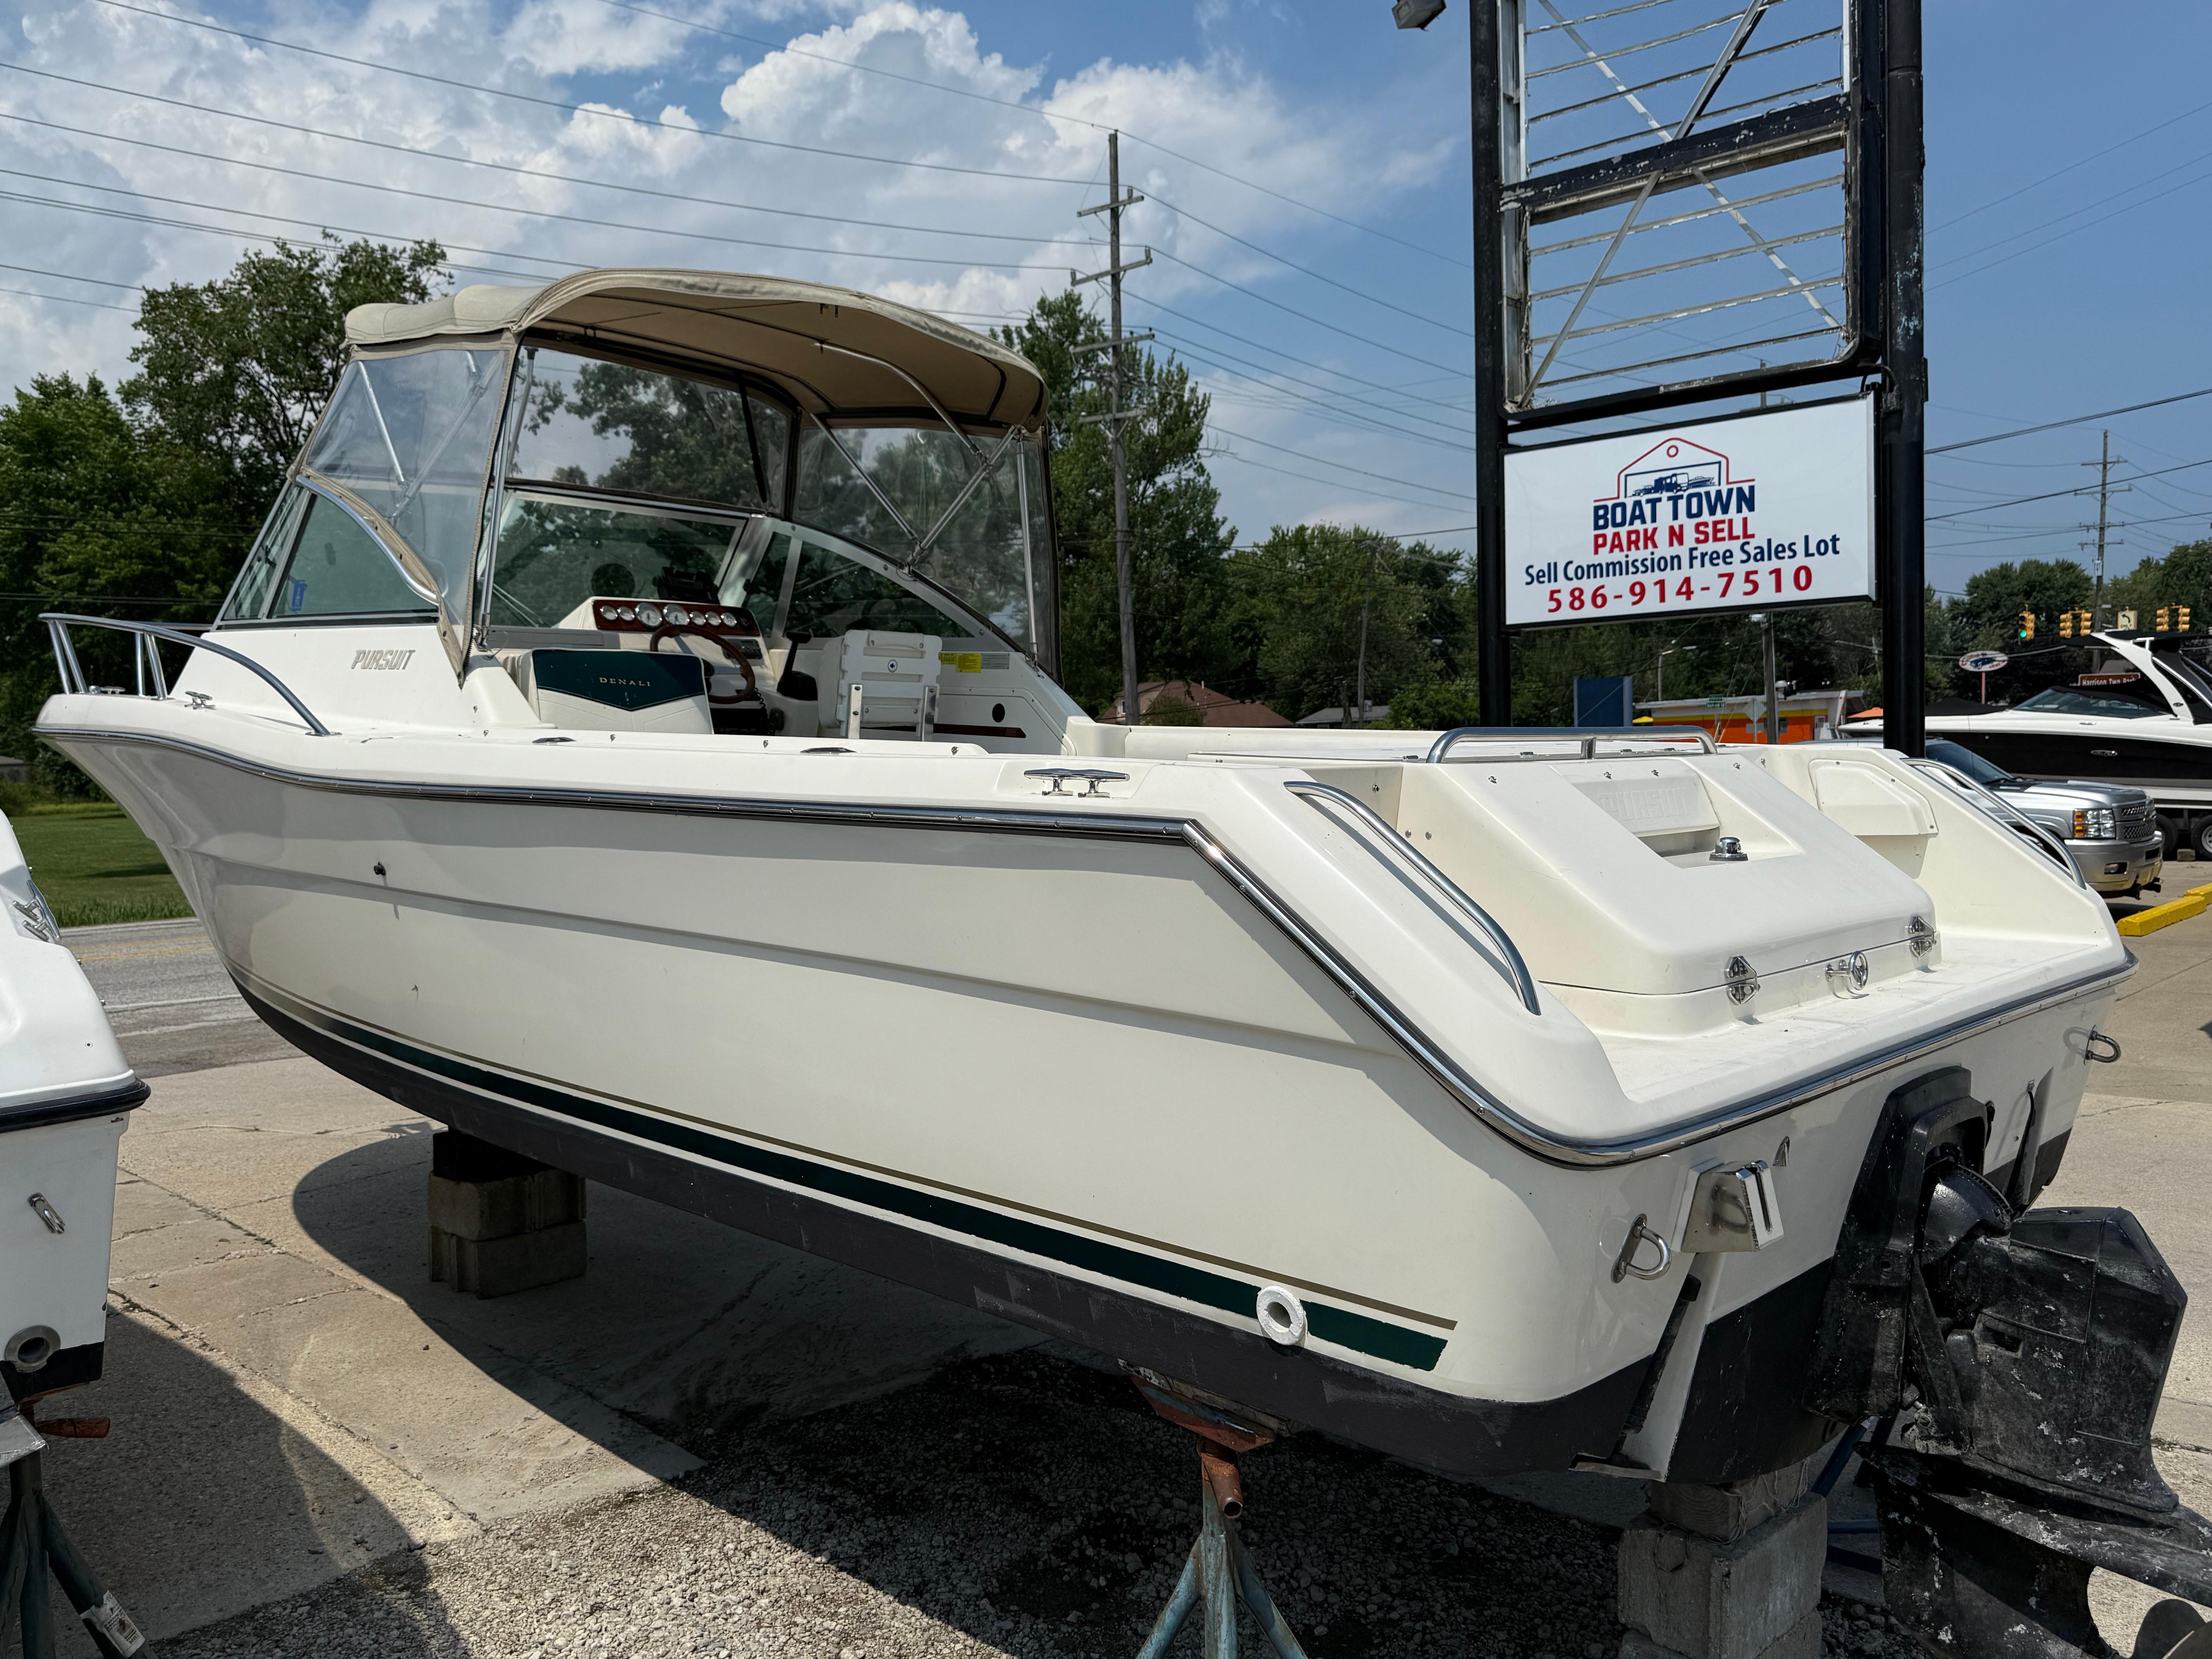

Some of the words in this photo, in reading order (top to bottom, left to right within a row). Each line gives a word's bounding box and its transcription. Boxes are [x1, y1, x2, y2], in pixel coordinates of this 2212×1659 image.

[1593, 497, 1662, 531] BOAT
[1667, 485, 1755, 521] TOWN
[1594, 527, 1658, 555] PARK
[1669, 524, 1683, 547] N
[1695, 517, 1755, 544] SELL
[1525, 562, 1558, 586] Sell
[1563, 551, 1682, 581] Commission
[1688, 546, 1734, 569] Free
[1740, 538, 1797, 564] Sales
[1804, 534, 1840, 558] Lot
[1548, 565, 1812, 612] 586-914-7510
[351, 650, 416, 670] PURSUIT
[599, 677, 650, 687] DENALI
[1598, 787, 1691, 821] PURSUIT
